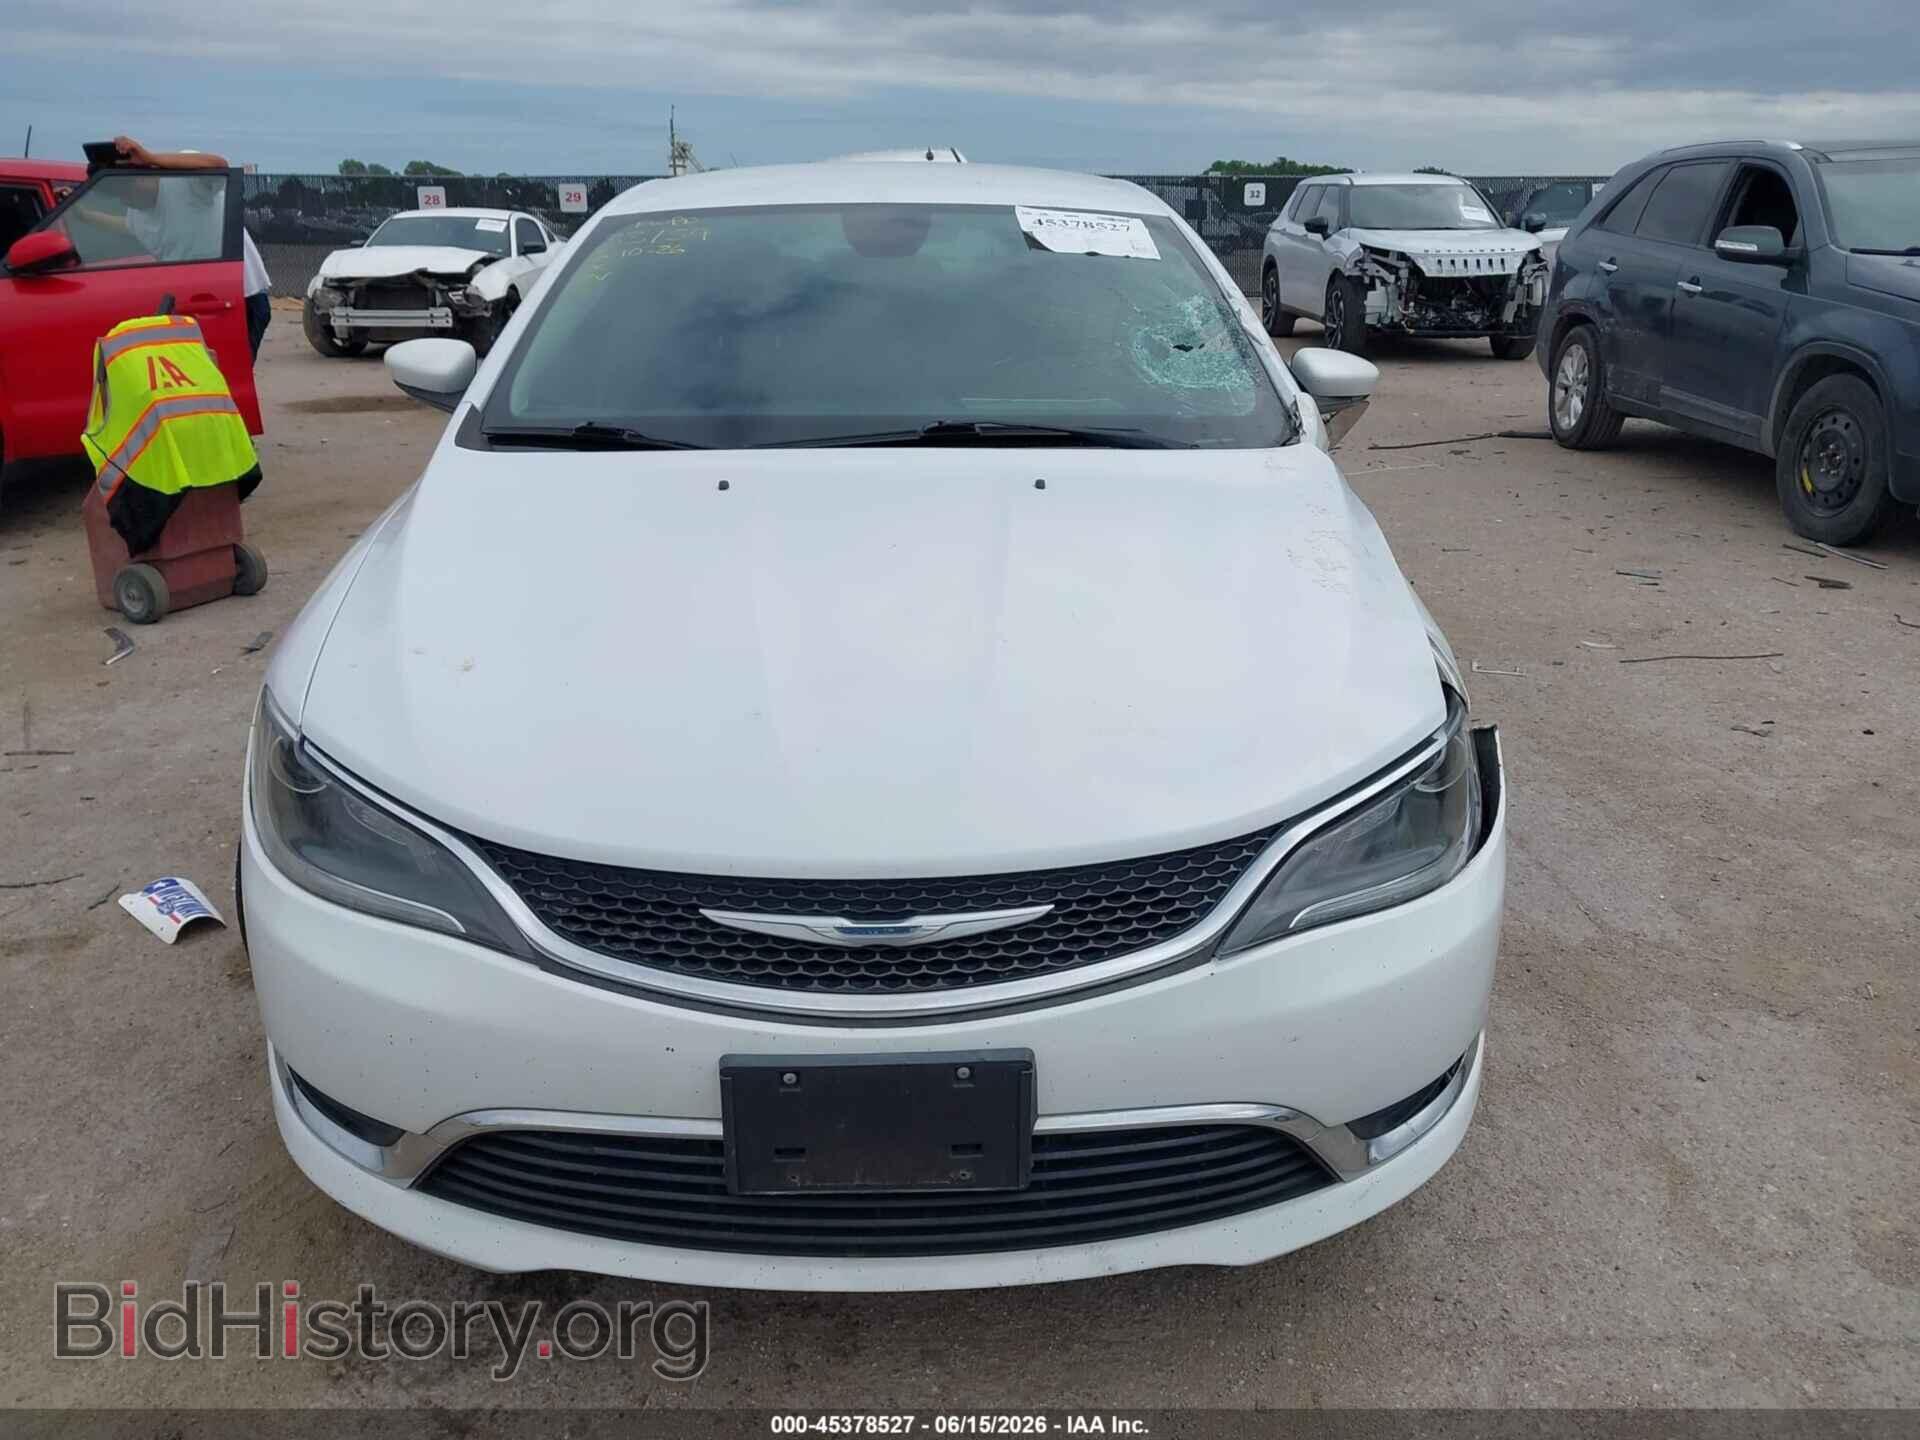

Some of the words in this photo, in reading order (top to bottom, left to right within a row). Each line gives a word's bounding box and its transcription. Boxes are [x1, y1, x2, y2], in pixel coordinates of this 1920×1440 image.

[424, 194, 441, 206] 28
[565, 192, 582, 202] 29
[1033, 217, 1130, 232] 45378527
